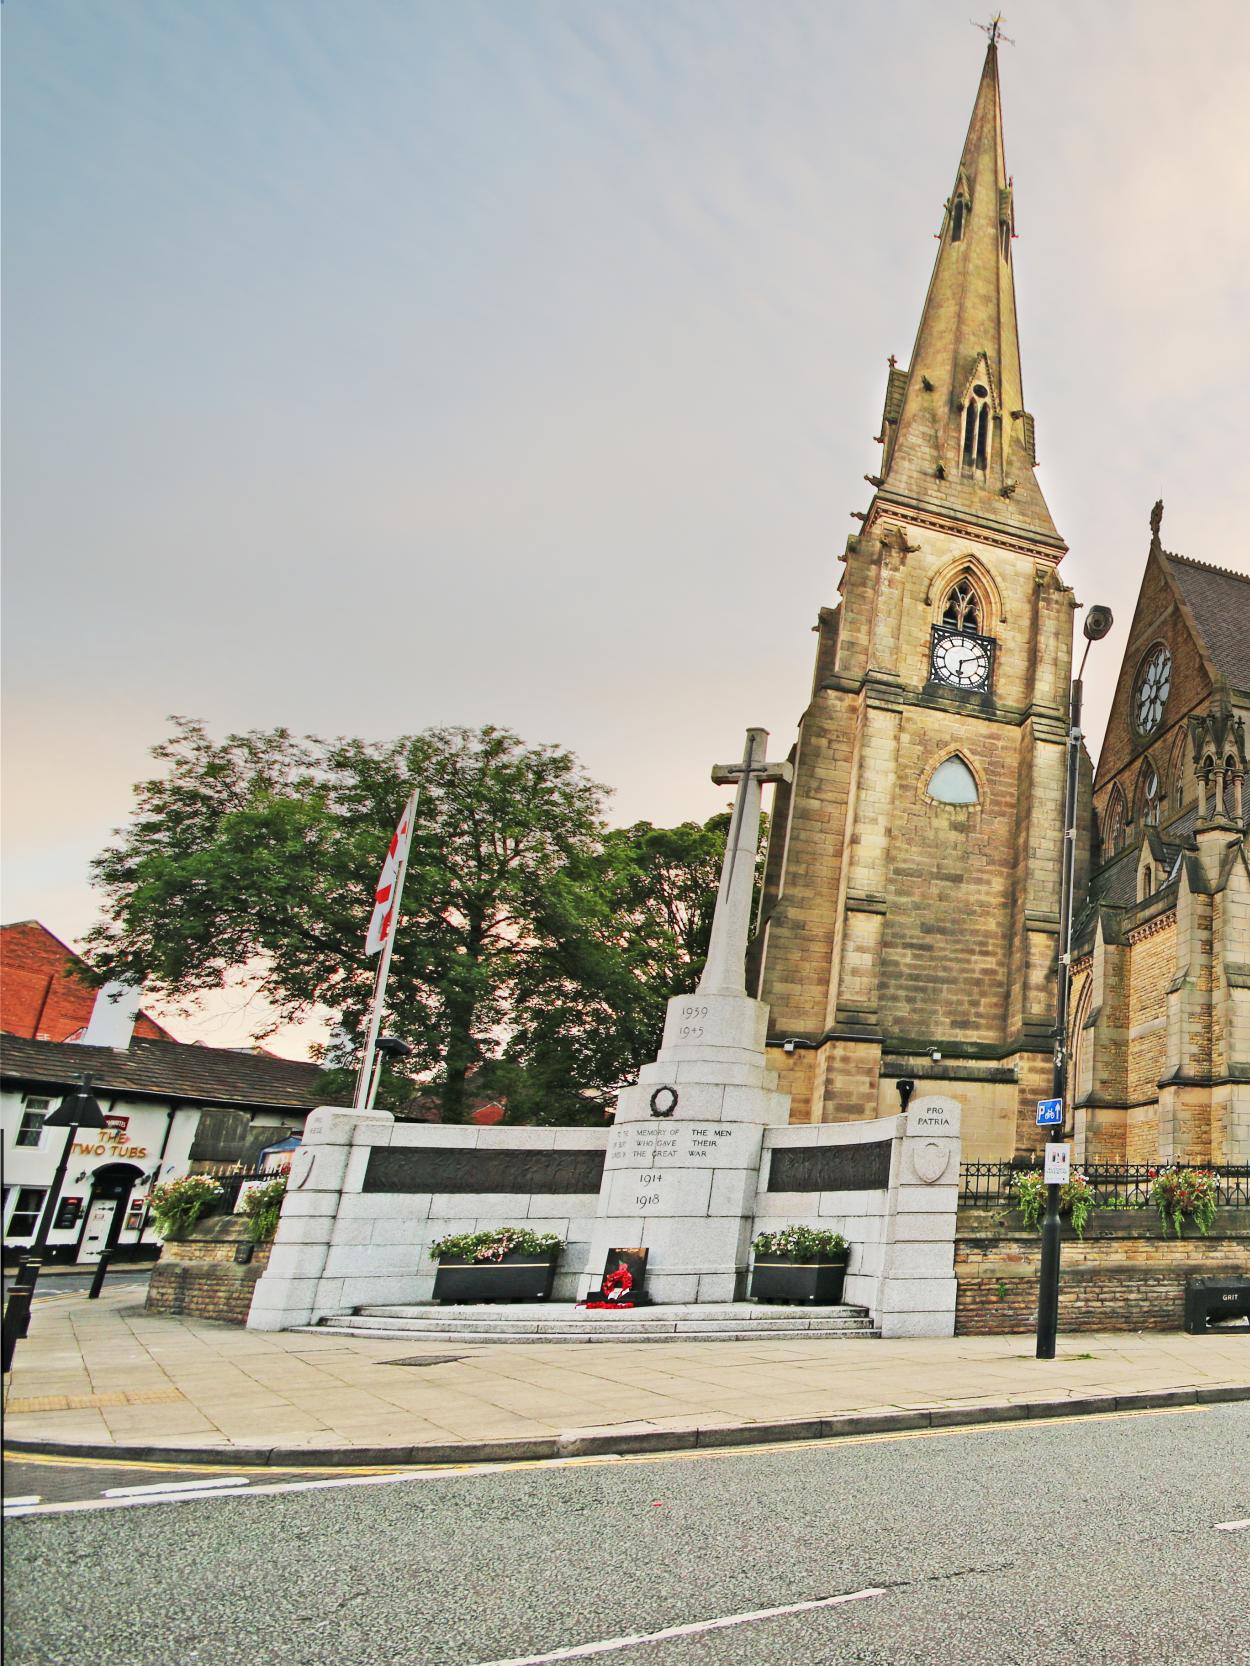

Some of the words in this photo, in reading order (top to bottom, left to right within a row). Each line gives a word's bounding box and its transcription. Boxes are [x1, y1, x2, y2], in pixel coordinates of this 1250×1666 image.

[682, 1006, 708, 1020] 1939
[679, 1026, 704, 1040] 1945
[926, 1107, 944, 1115] PRO
[1038, 1105, 1045, 1120] P
[98, 1130, 128, 1143] THE
[636, 1129, 666, 1137] MEMORY
[692, 1129, 708, 1137] THE
[72, 1143, 106, 1156] TWO
[111, 1146, 147, 1159] TUBS
[692, 1140, 718, 1148] THEIR
[633, 1150, 646, 1158] THE
[651, 1150, 679, 1159] GREAT
[688, 1150, 707, 1158] WAR
[639, 1173, 662, 1187] 1914
[636, 1193, 660, 1210] 1918
